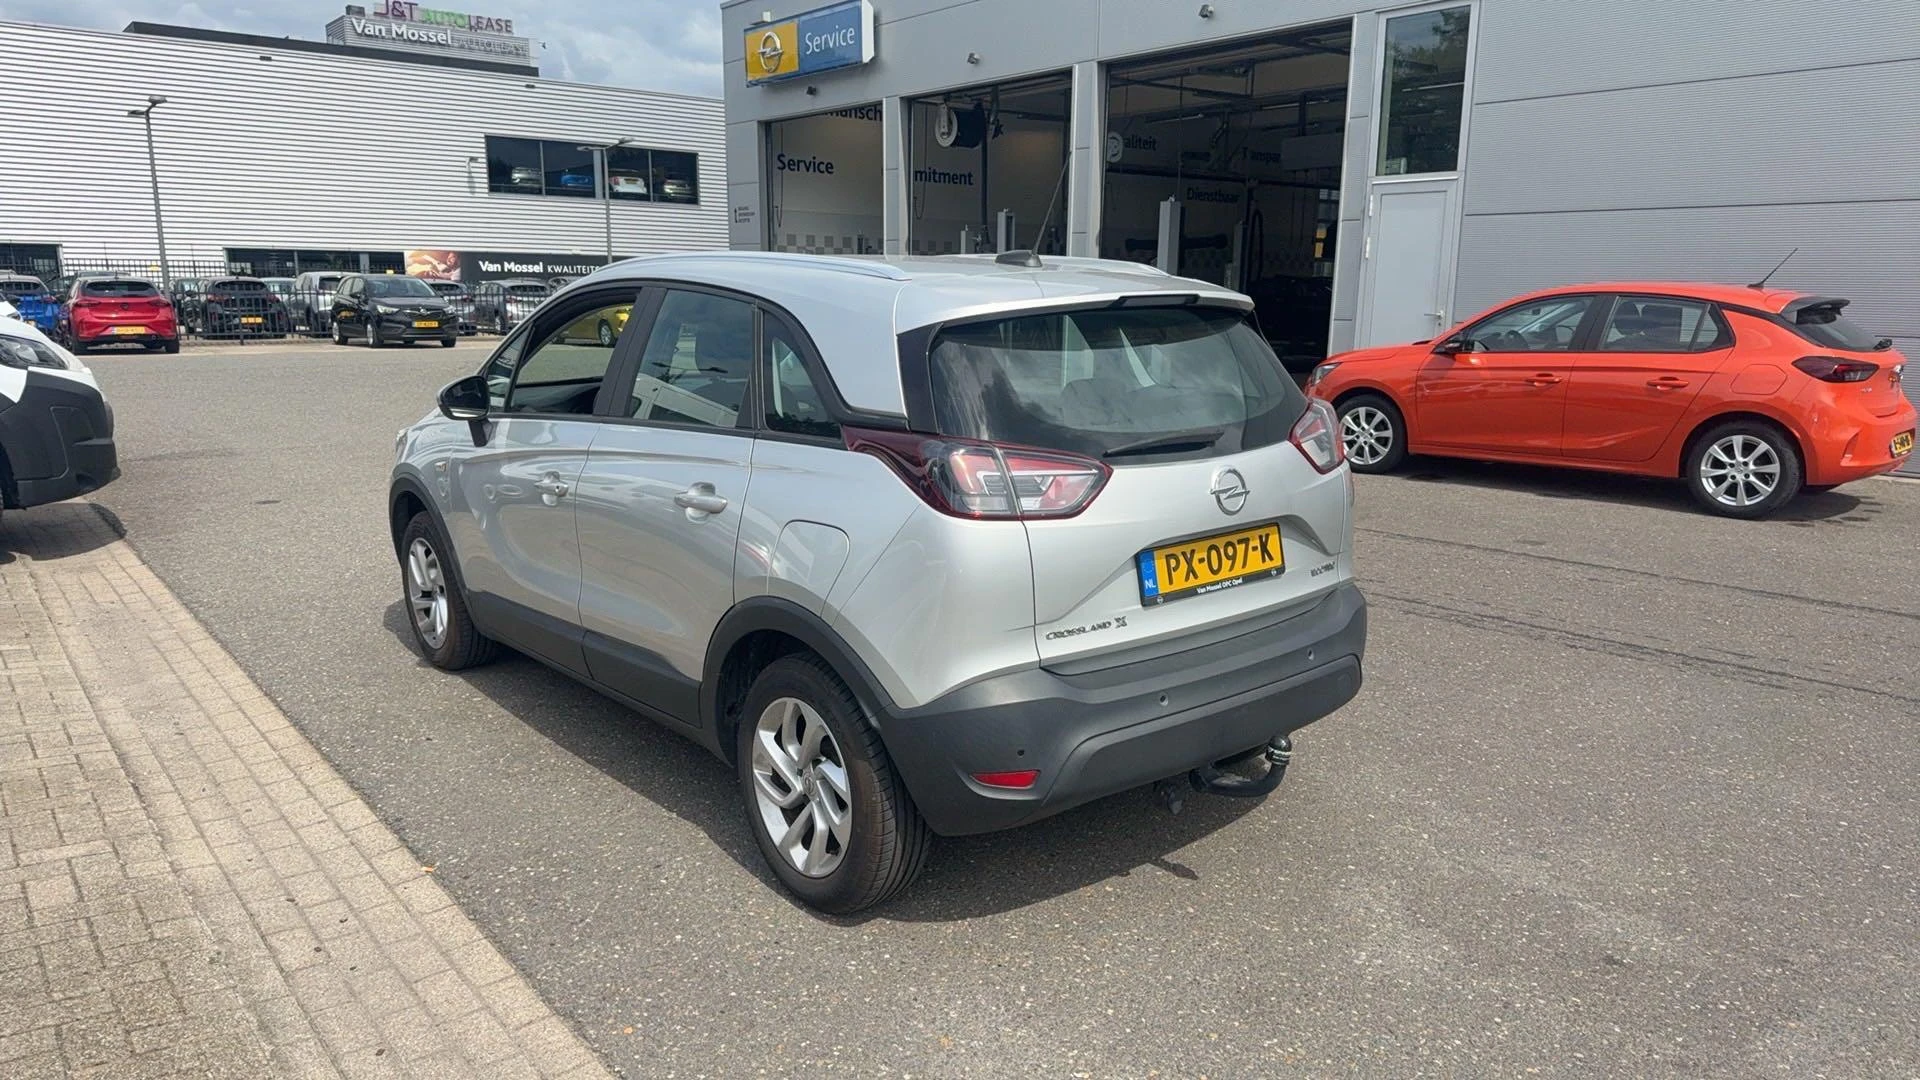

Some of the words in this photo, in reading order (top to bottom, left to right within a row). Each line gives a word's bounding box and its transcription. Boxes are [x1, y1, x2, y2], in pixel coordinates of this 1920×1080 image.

[373, 0, 418, 21] J&T
[350, 18, 386, 37] Van
[391, 23, 451, 45] Mossel
[805, 26, 855, 55] Service
[777, 153, 834, 175] Service
[914, 167, 974, 185] mitment
[478, 260, 501, 272] Van
[504, 261, 543, 273] Mossel
[1166, 531, 1274, 585] PX-097-K
[1144, 578, 1156, 589] NL
